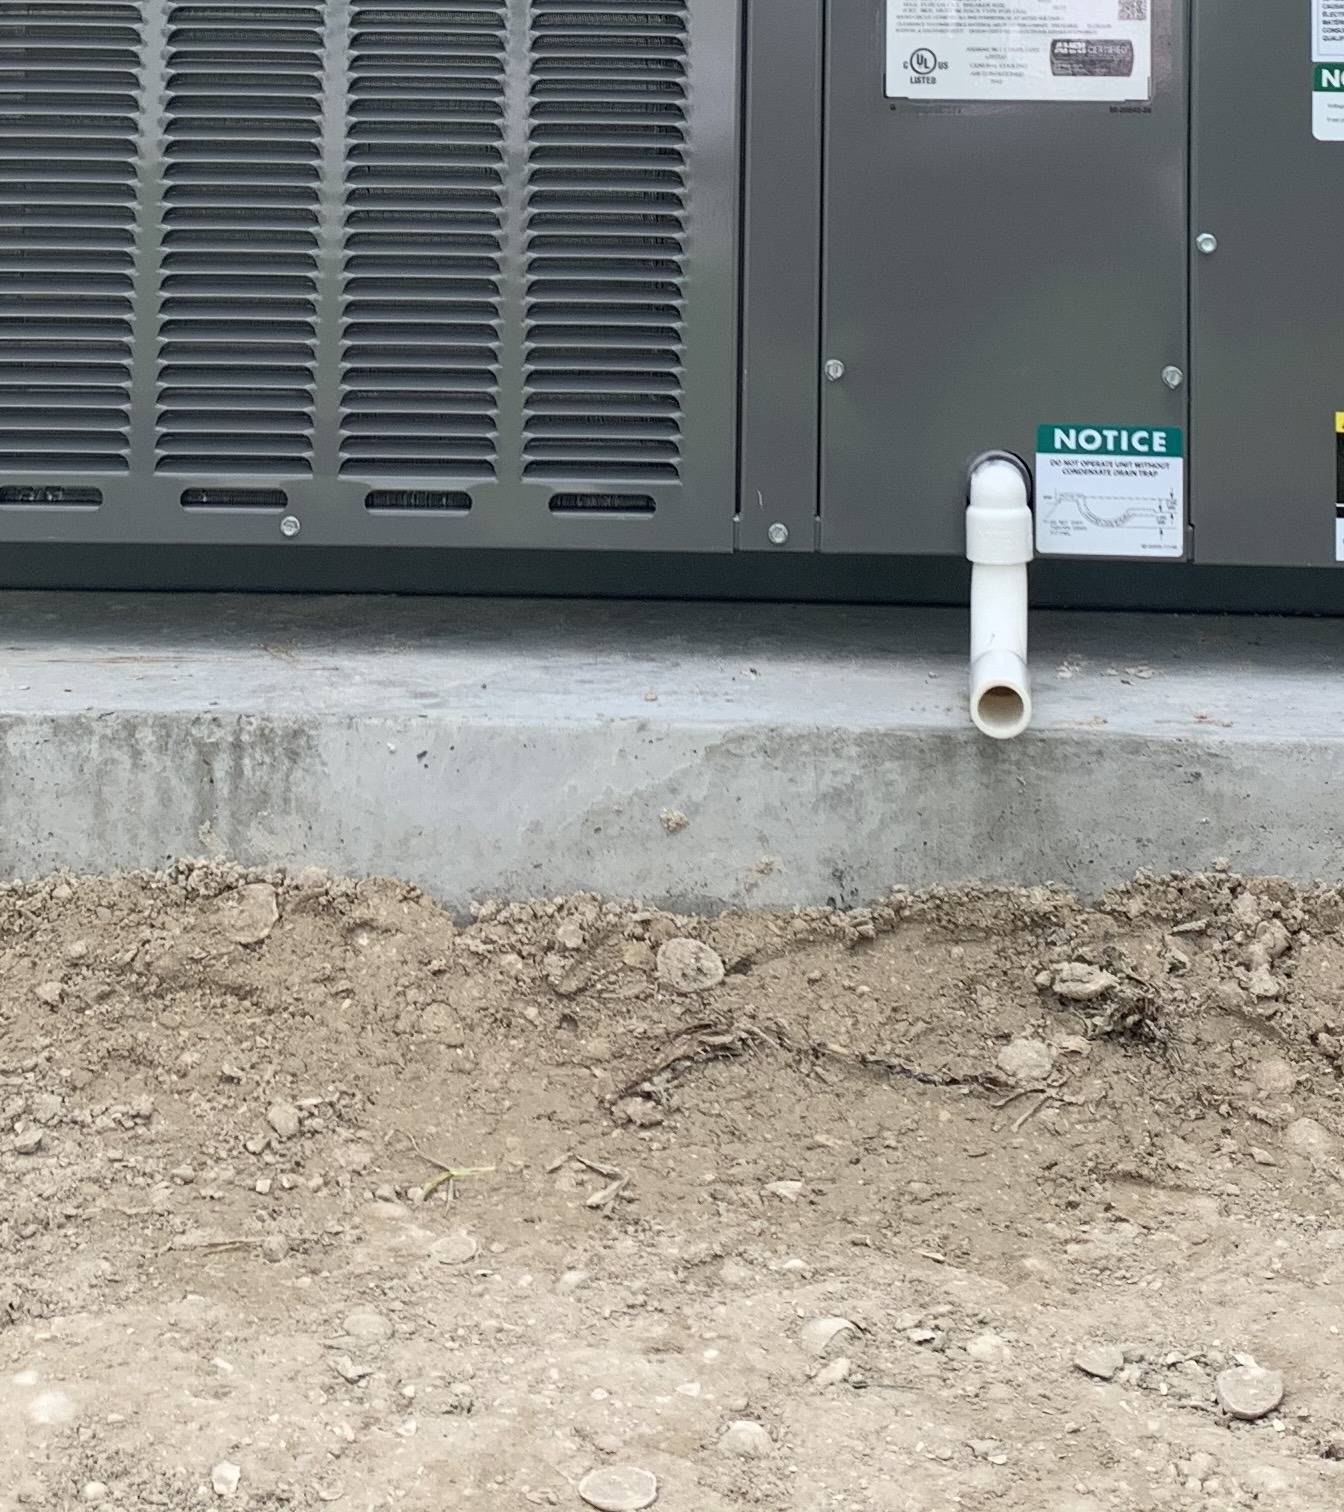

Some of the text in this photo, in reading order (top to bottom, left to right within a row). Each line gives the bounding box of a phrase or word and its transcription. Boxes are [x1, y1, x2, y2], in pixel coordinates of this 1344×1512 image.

[916, 53, 929, 69] UL
[910, 76, 936, 84] LISTED
[1054, 428, 1166, 452] NOTICE
